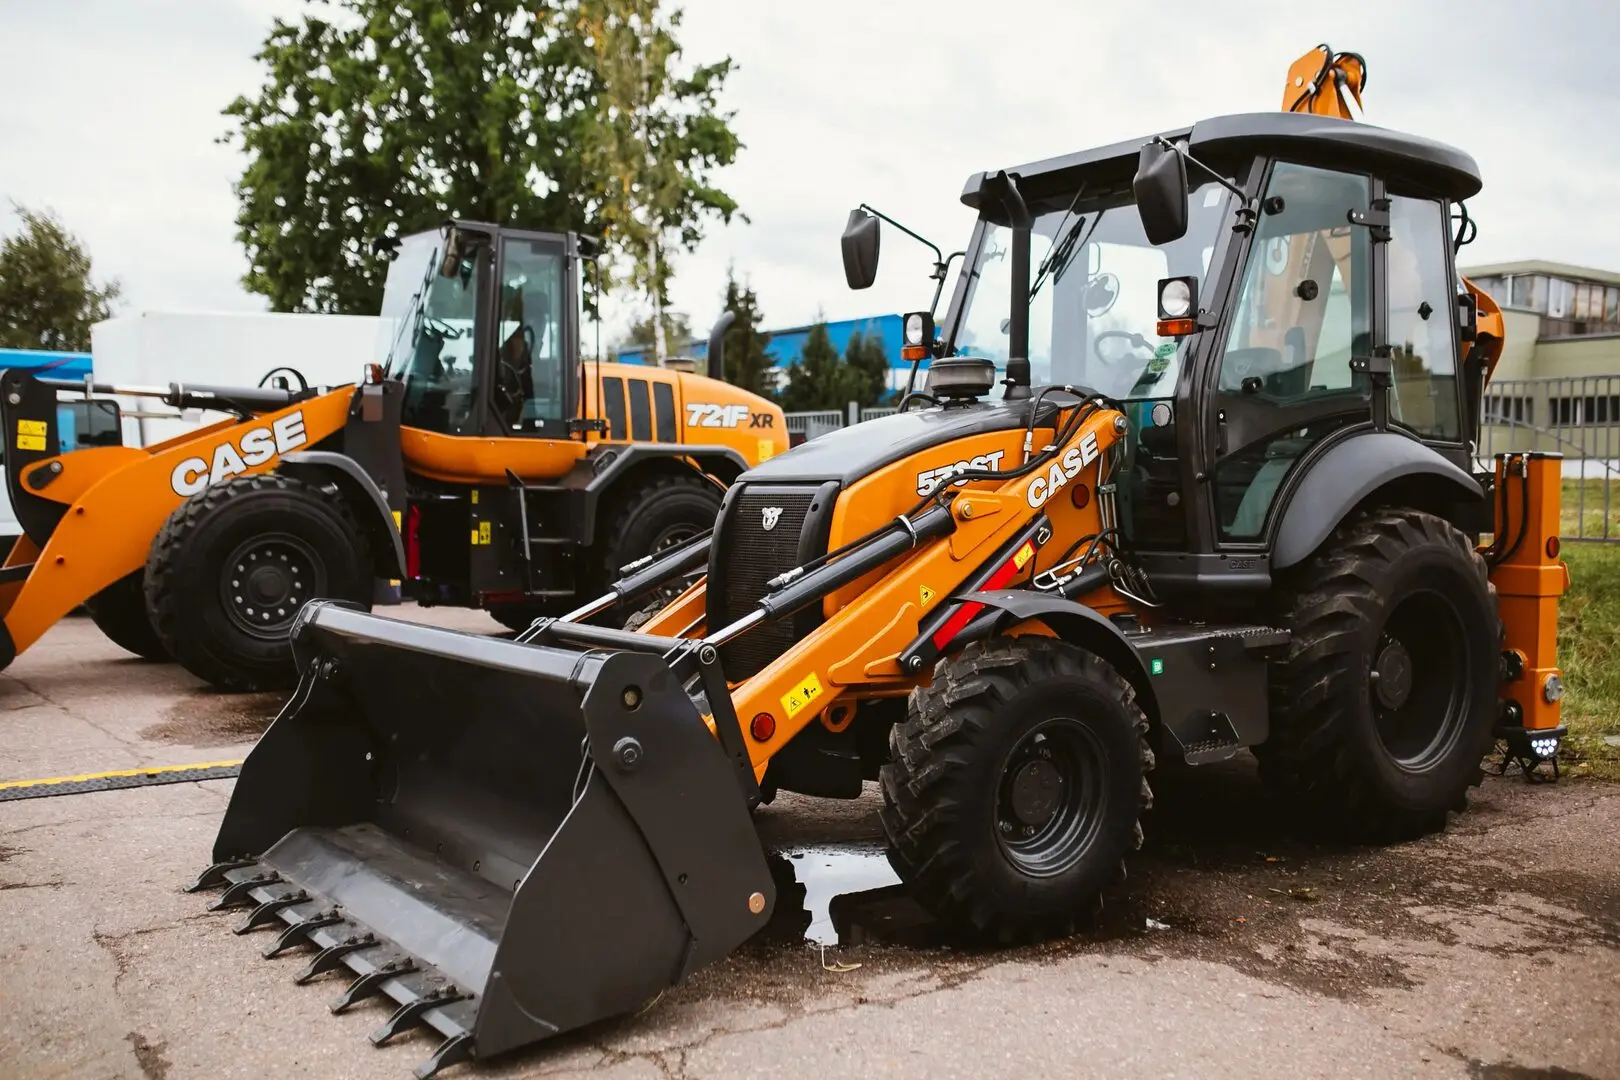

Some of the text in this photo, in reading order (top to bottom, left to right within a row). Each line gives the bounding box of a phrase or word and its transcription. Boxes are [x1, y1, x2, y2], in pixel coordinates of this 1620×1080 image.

[686, 403, 774, 429] 721F XR
[171, 409, 307, 497] CASE
[1027, 431, 1099, 508] CASE
[1230, 560, 1256, 569] CASE
